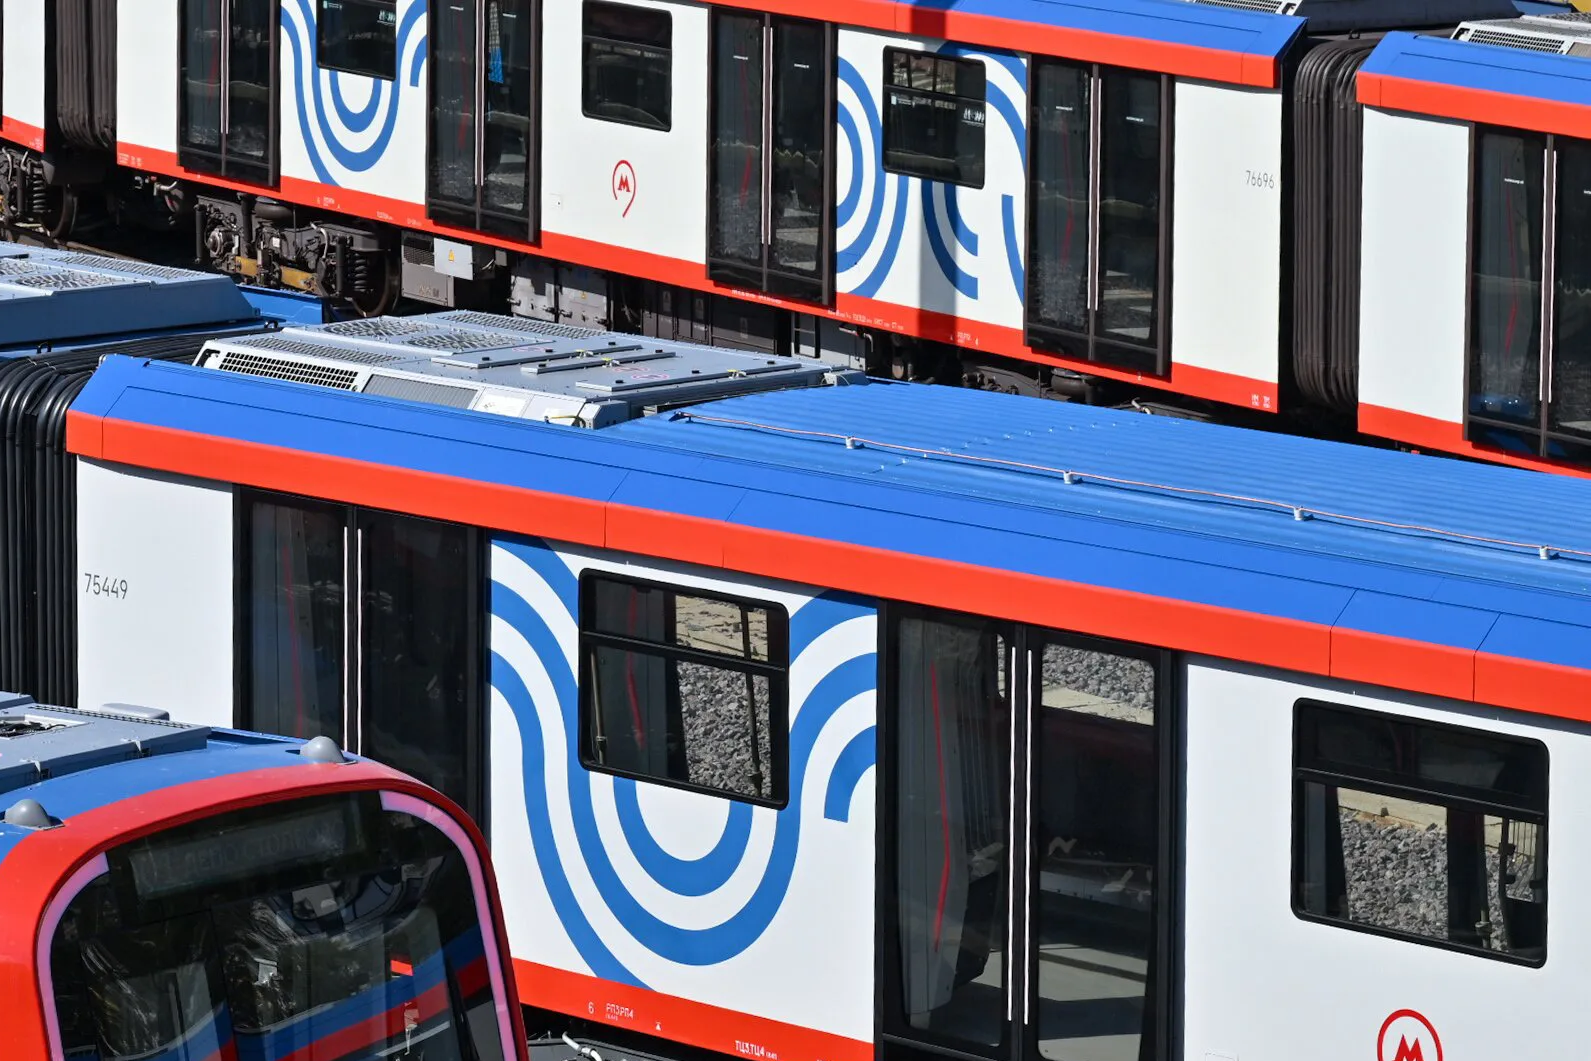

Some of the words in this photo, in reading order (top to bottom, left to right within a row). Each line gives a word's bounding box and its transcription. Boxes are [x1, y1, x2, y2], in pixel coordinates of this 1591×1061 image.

[1245, 169, 1275, 189] 76696
[84, 572, 128, 600] 75449
[588, 1001, 595, 1015] 6
